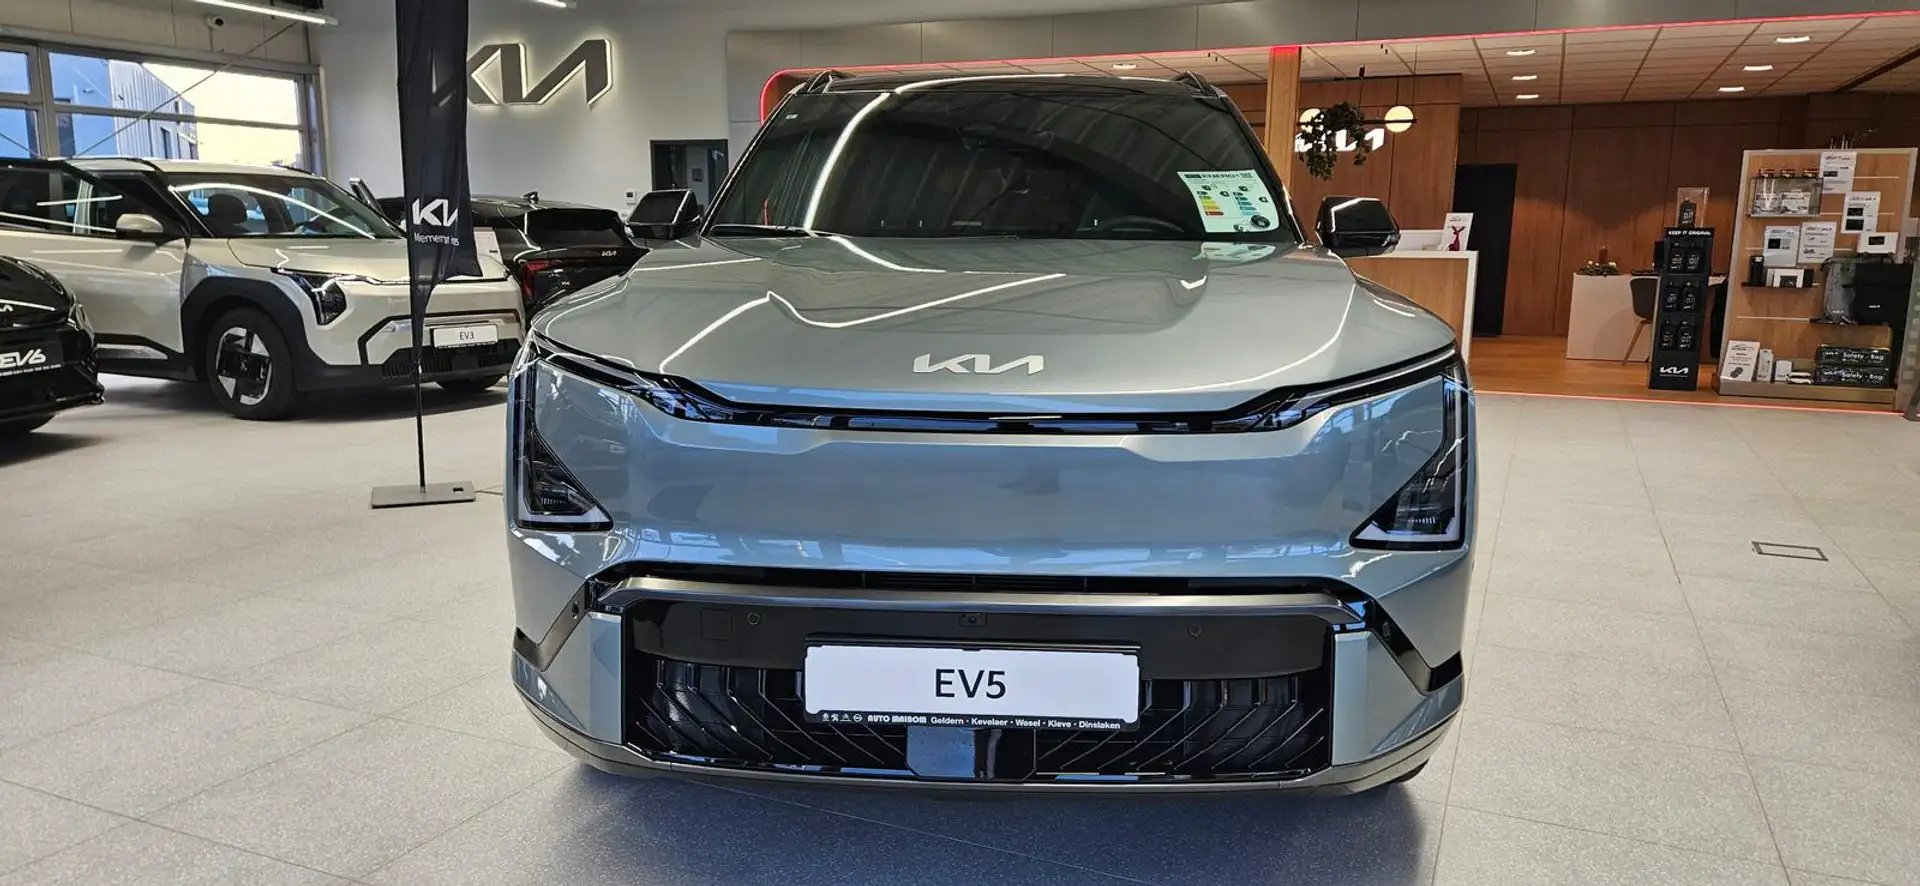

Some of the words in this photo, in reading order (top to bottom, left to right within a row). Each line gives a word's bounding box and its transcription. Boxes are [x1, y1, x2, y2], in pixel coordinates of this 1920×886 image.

[459, 331, 475, 341] EV3
[0, 348, 47, 369] EV6
[913, 353, 1044, 376] KIA
[1659, 366, 1689, 375] KIA
[935, 668, 1007, 699] EV5
[867, 714, 890, 723] AUTO
[891, 715, 927, 724] MAIBOM
[930, 716, 965, 726] Geldern
[970, 717, 1008, 727] Kevelaer
[1015, 718, 1041, 728] Wesel
[1047, 719, 1072, 729] Kleve
[1078, 720, 1121, 730] Dinslaken
